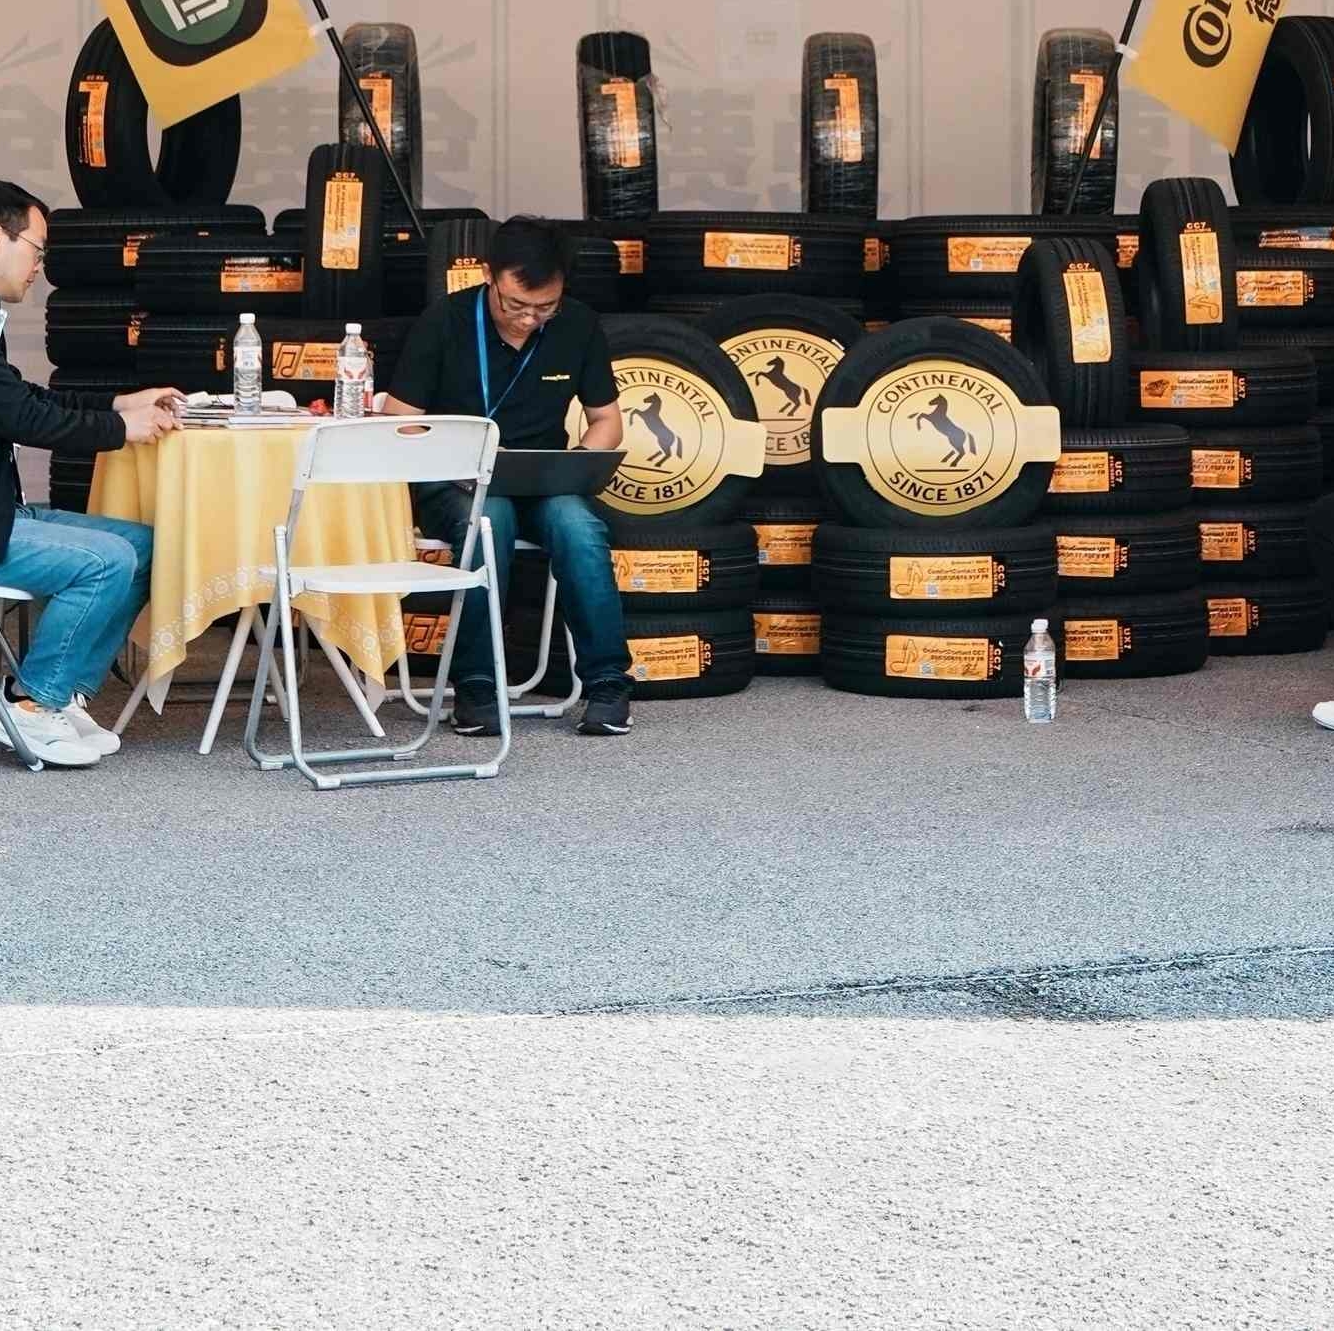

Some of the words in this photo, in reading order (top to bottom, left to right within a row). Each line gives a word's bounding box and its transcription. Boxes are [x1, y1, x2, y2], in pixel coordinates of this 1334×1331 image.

[729, 338, 836, 373] ONTINENTAL
[613, 368, 713, 423] NTINENTAL
[877, 372, 1003, 415] CONTINENTAL
[888, 471, 949, 502] SINCE
[954, 469, 997, 500] 1871
[1114, 460, 1123, 483] UC7
[608, 476, 647, 500] NCE
[652, 475, 696, 500] 1871
[997, 564, 1006, 587] CC7
[994, 647, 1002, 671] CC7
